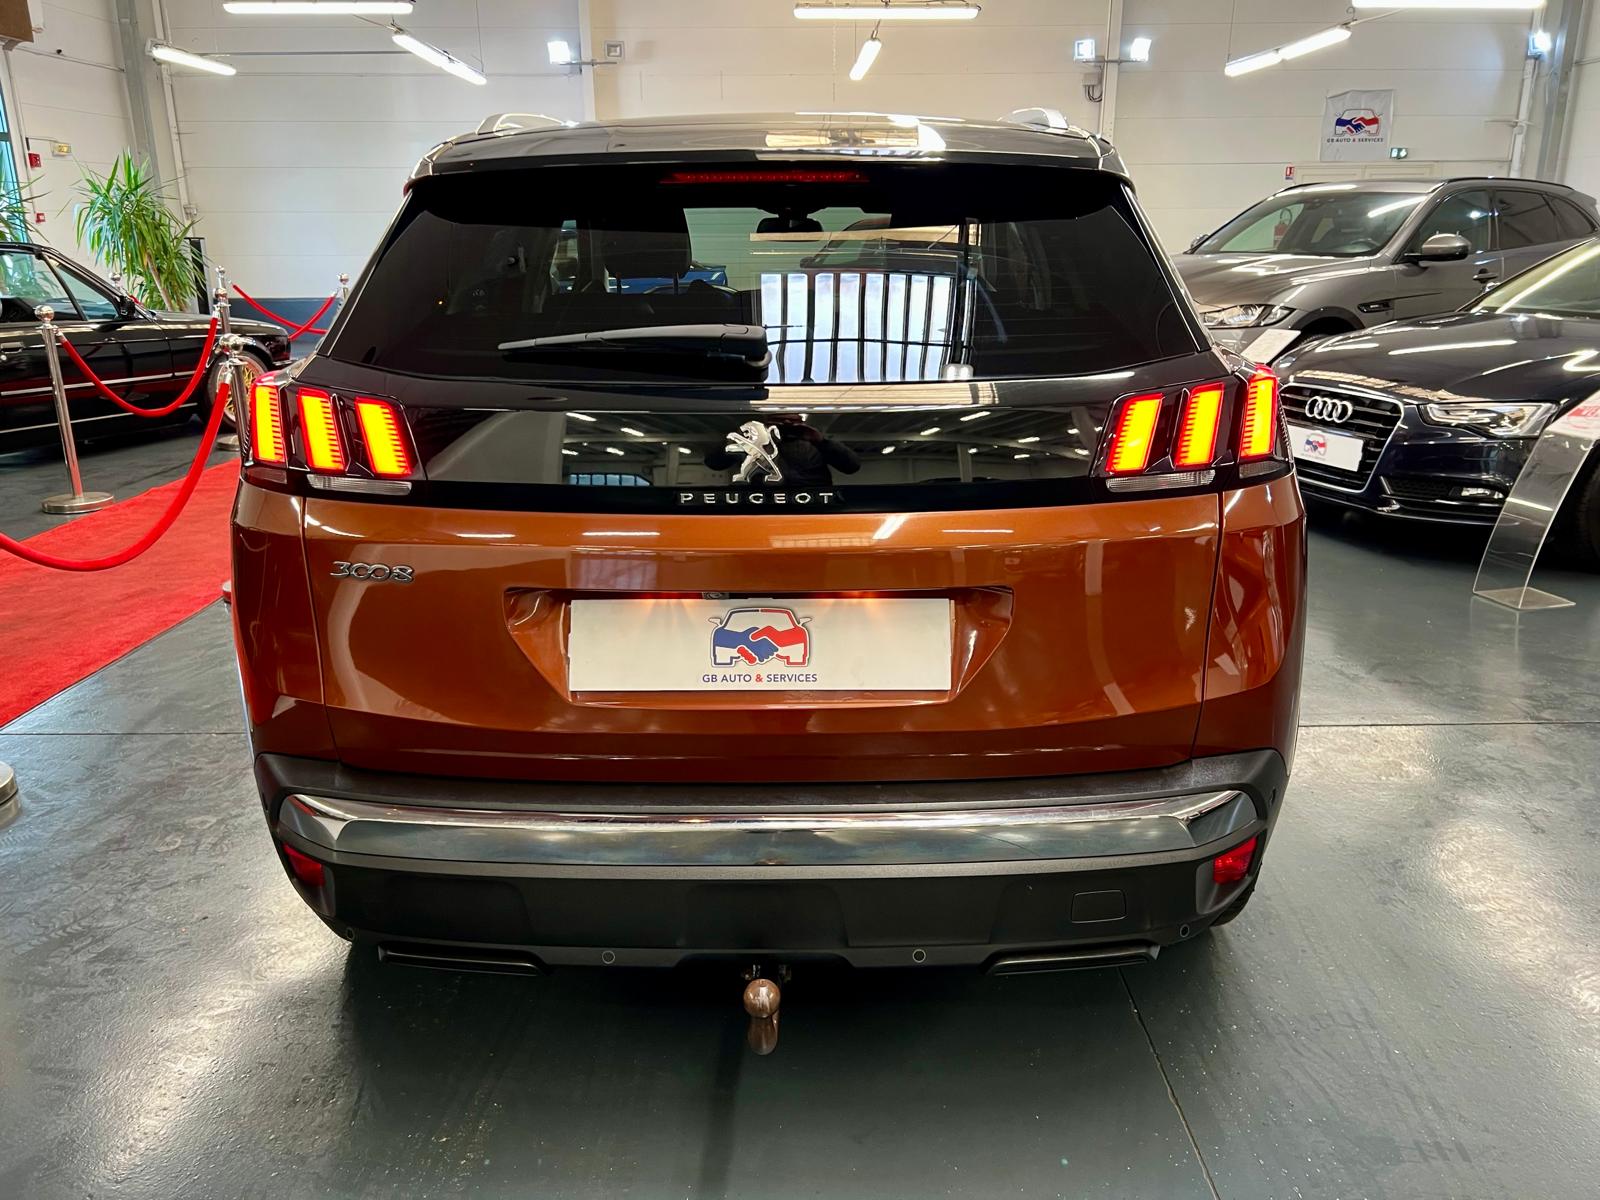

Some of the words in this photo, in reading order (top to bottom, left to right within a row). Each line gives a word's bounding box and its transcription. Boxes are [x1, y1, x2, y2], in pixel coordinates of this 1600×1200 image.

[679, 492, 834, 504] PEUGEOT
[329, 560, 414, 584] 3008
[702, 674, 718, 683] GB
[720, 673, 752, 683] AUTO
[755, 673, 763, 683] &
[766, 673, 818, 683] SERVICES
